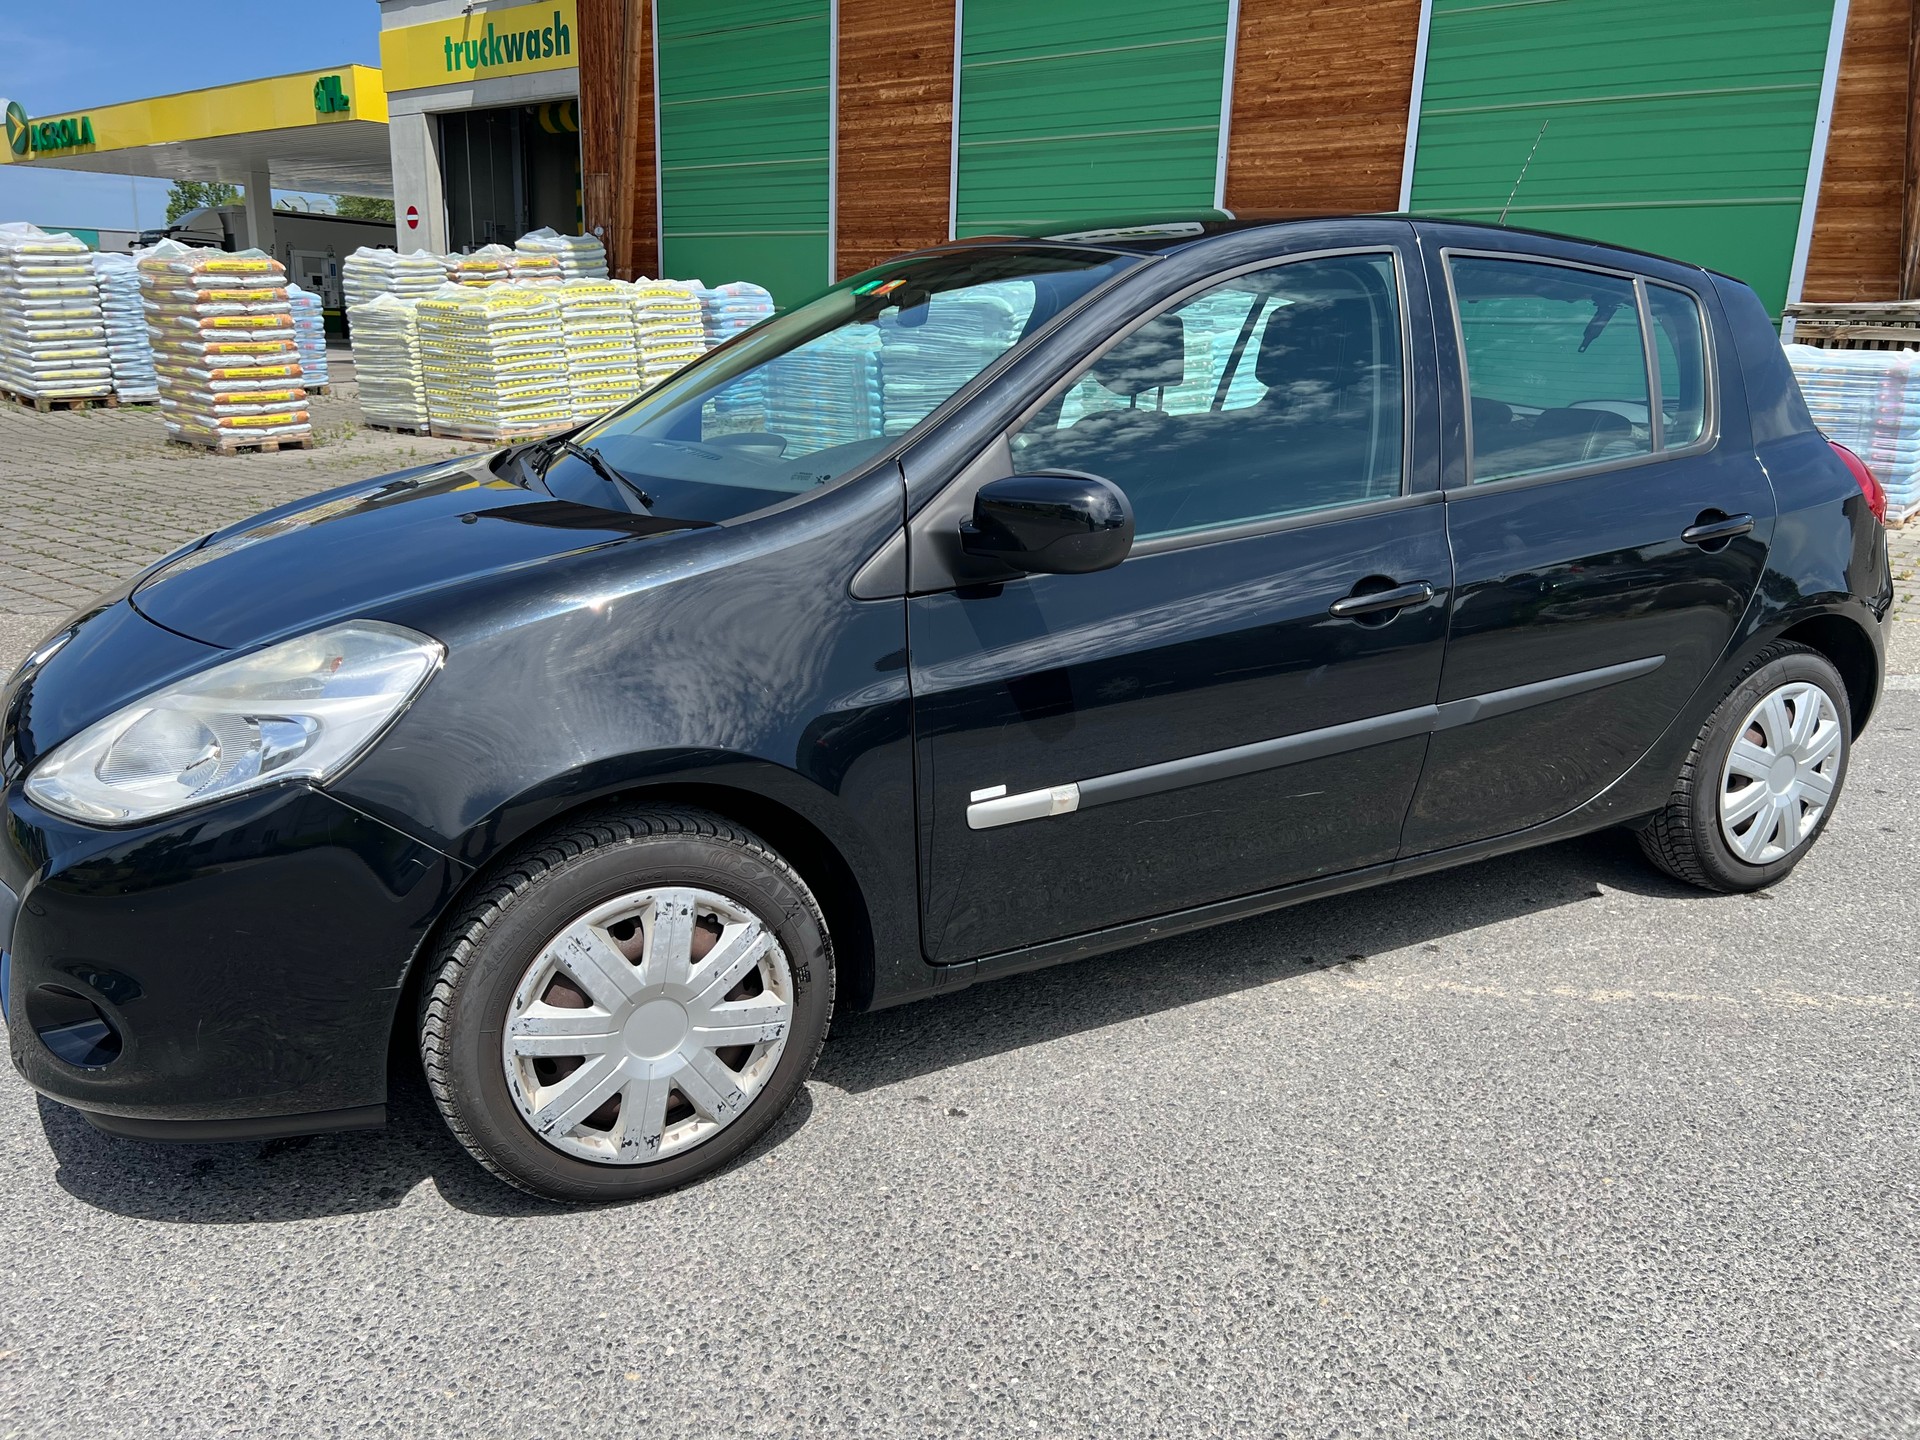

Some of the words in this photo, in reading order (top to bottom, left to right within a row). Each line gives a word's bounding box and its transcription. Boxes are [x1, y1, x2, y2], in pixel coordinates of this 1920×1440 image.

[444, 11, 570, 72] truckwash
[31, 116, 95, 152] AGROLA
[733, 857, 809, 929] SAVA
